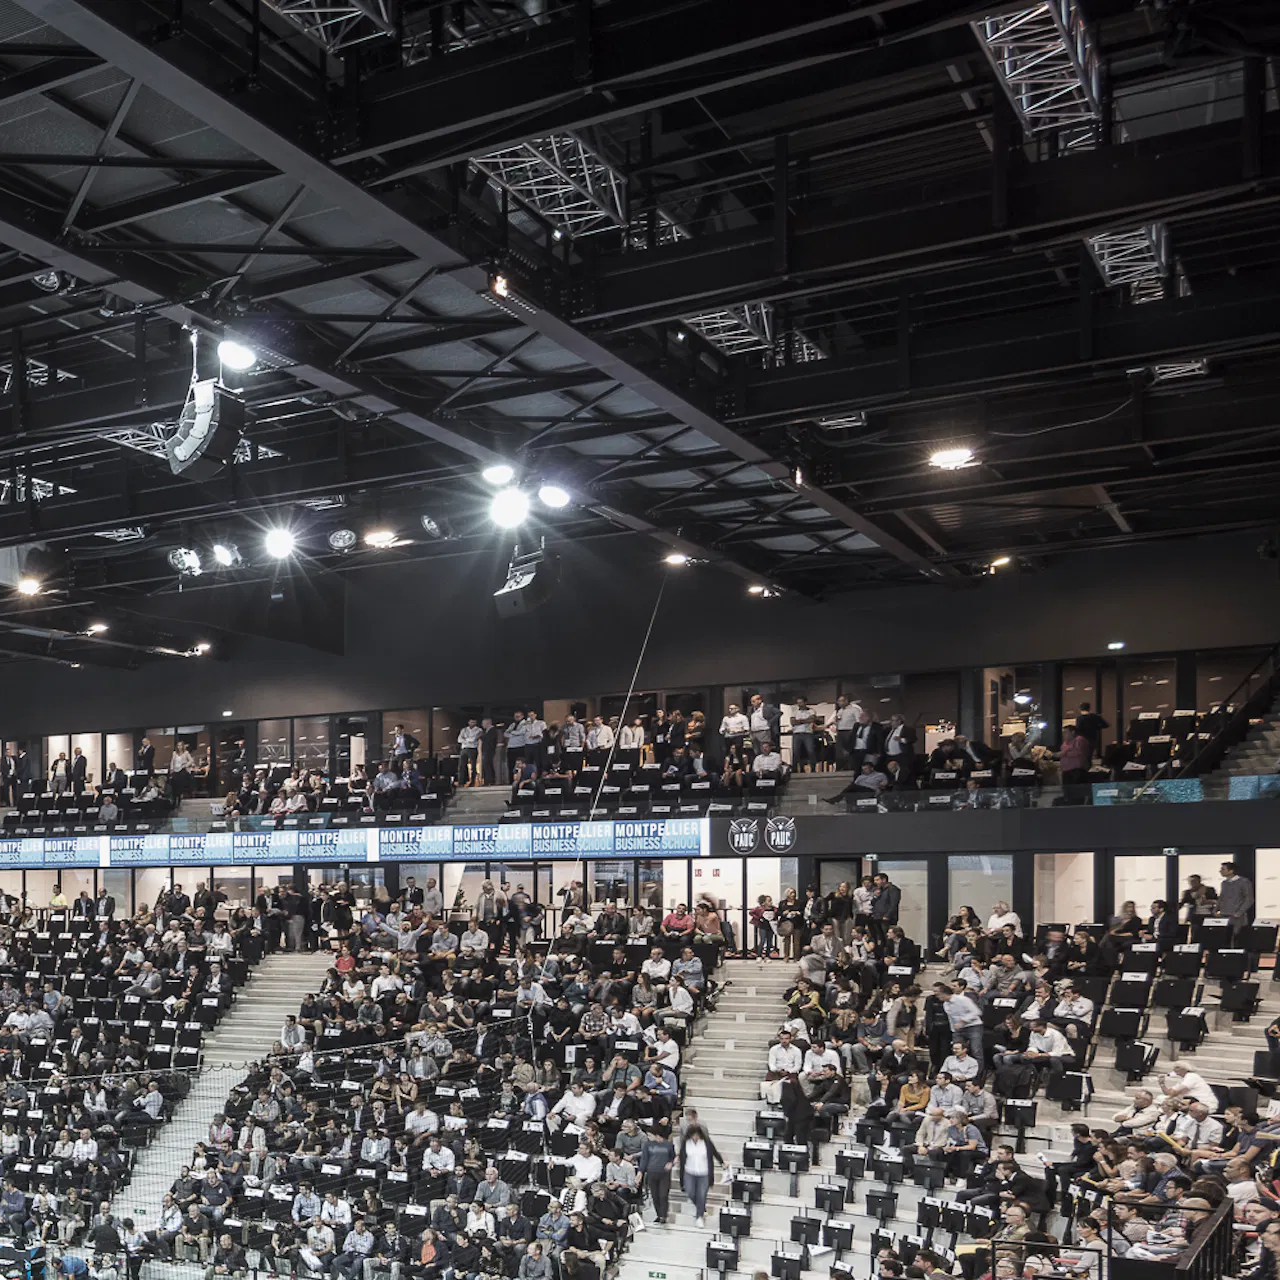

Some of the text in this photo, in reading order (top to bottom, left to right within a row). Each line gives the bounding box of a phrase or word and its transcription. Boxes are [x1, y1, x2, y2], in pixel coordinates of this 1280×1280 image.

[380, 828, 451, 843] MONTPELLIER
[454, 827, 529, 842] MONTPELLIER
[533, 824, 612, 840] MONTPELLIER
[615, 822, 699, 837] MONTPELLIER
[299, 830, 366, 846] MONTPELLIER
[533, 839, 576, 852] BUSINESS
[615, 836, 700, 851] BUSINESS SCHOOL
[733, 833, 755, 848] PAUC
[771, 831, 791, 846] PAUC
[380, 842, 419, 855] BUSINESS
[454, 841, 495, 854] BUSINESS
